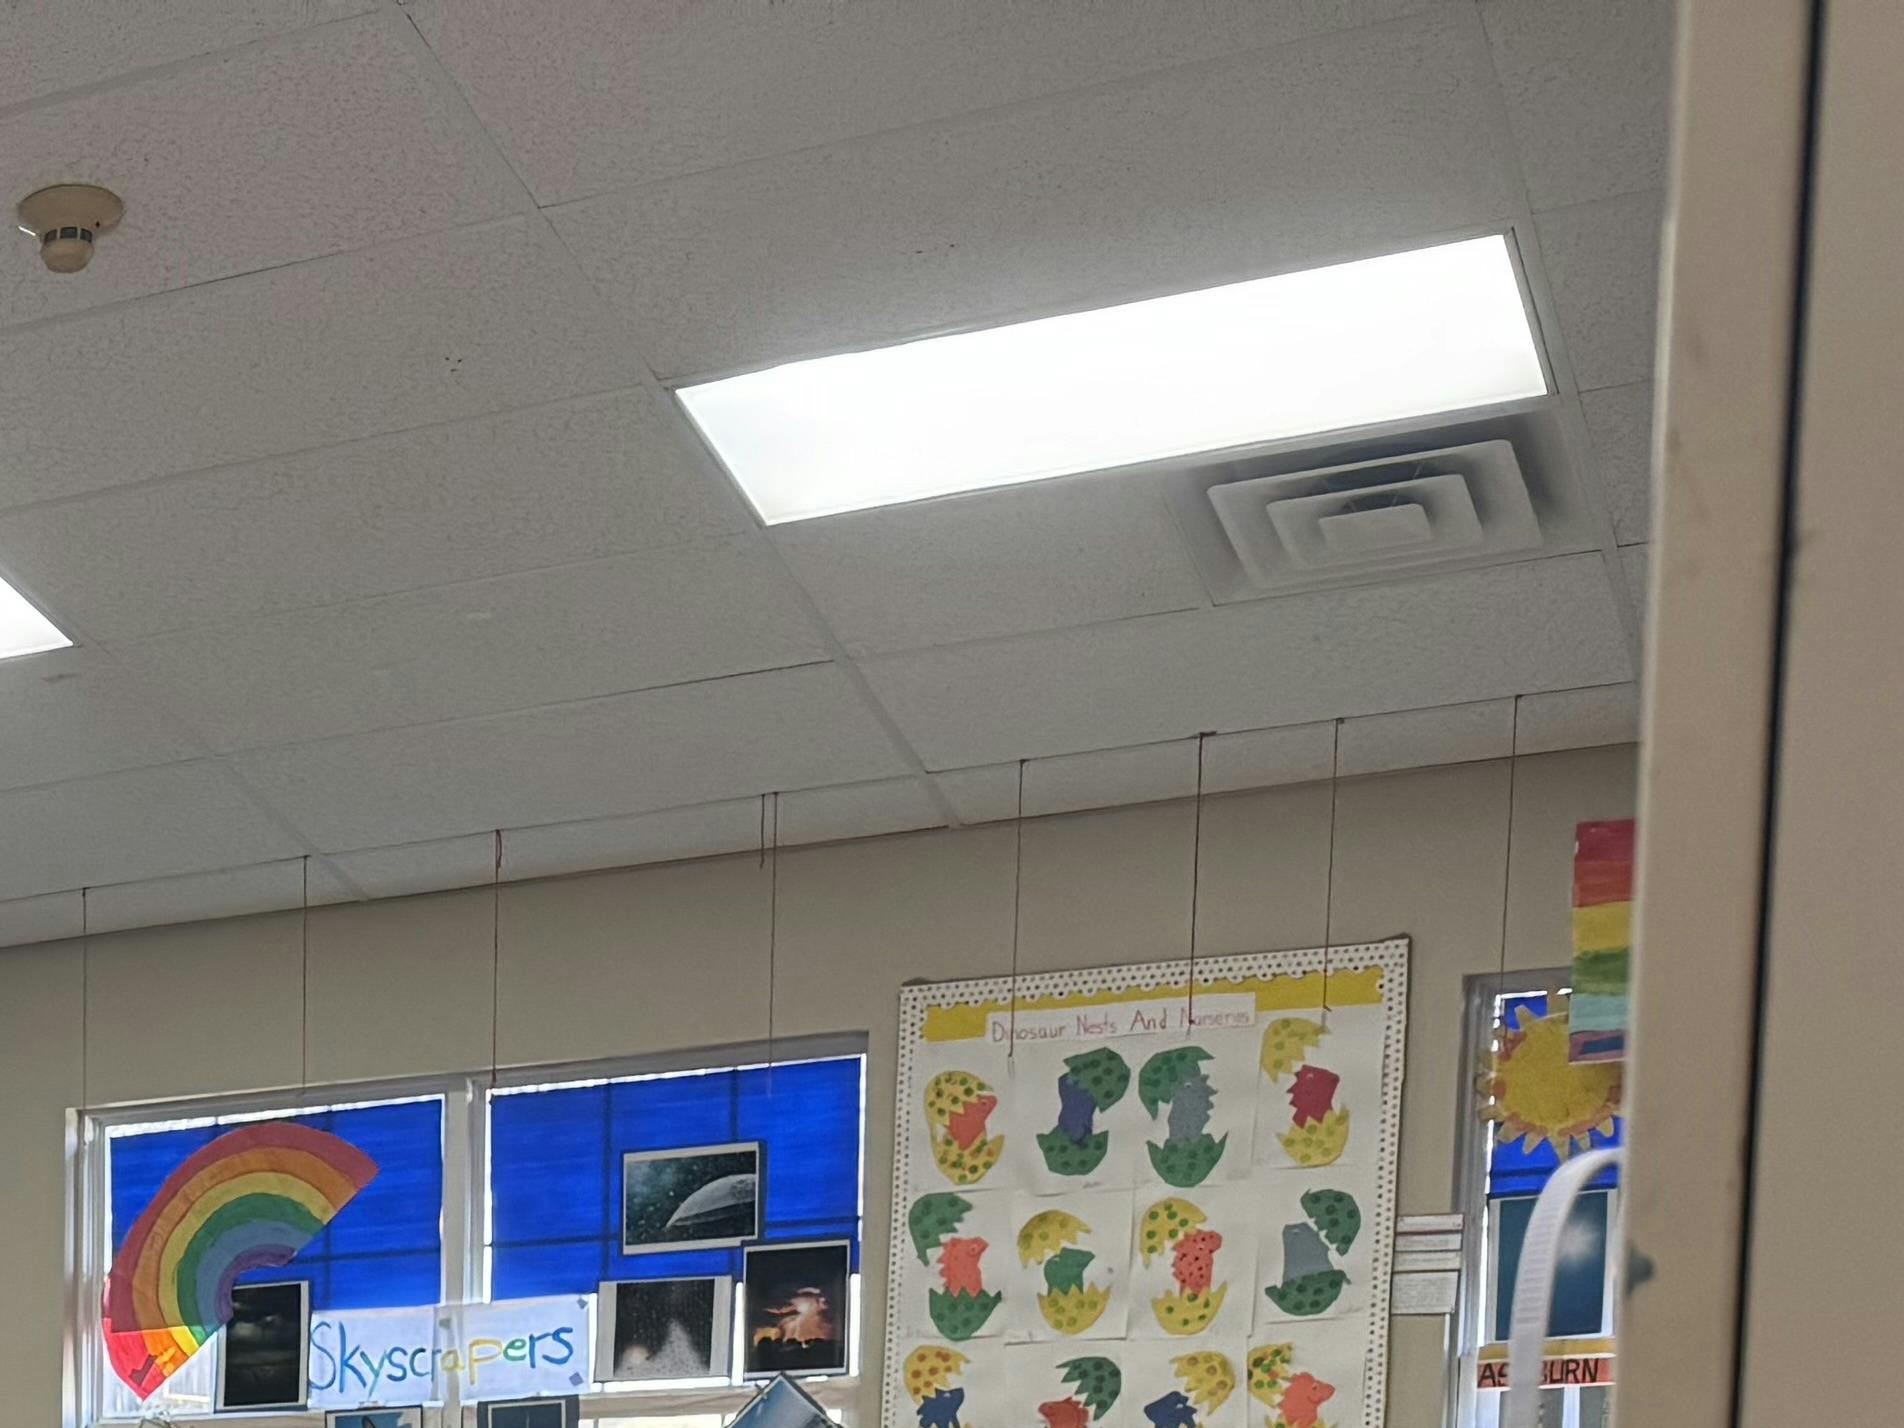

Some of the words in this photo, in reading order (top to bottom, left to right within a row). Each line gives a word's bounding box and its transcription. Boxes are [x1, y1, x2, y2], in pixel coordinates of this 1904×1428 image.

[1076, 1014, 1118, 1037] Nests
[1129, 1007, 1167, 1032] And
[308, 1318, 576, 1397] Skyscrapers
